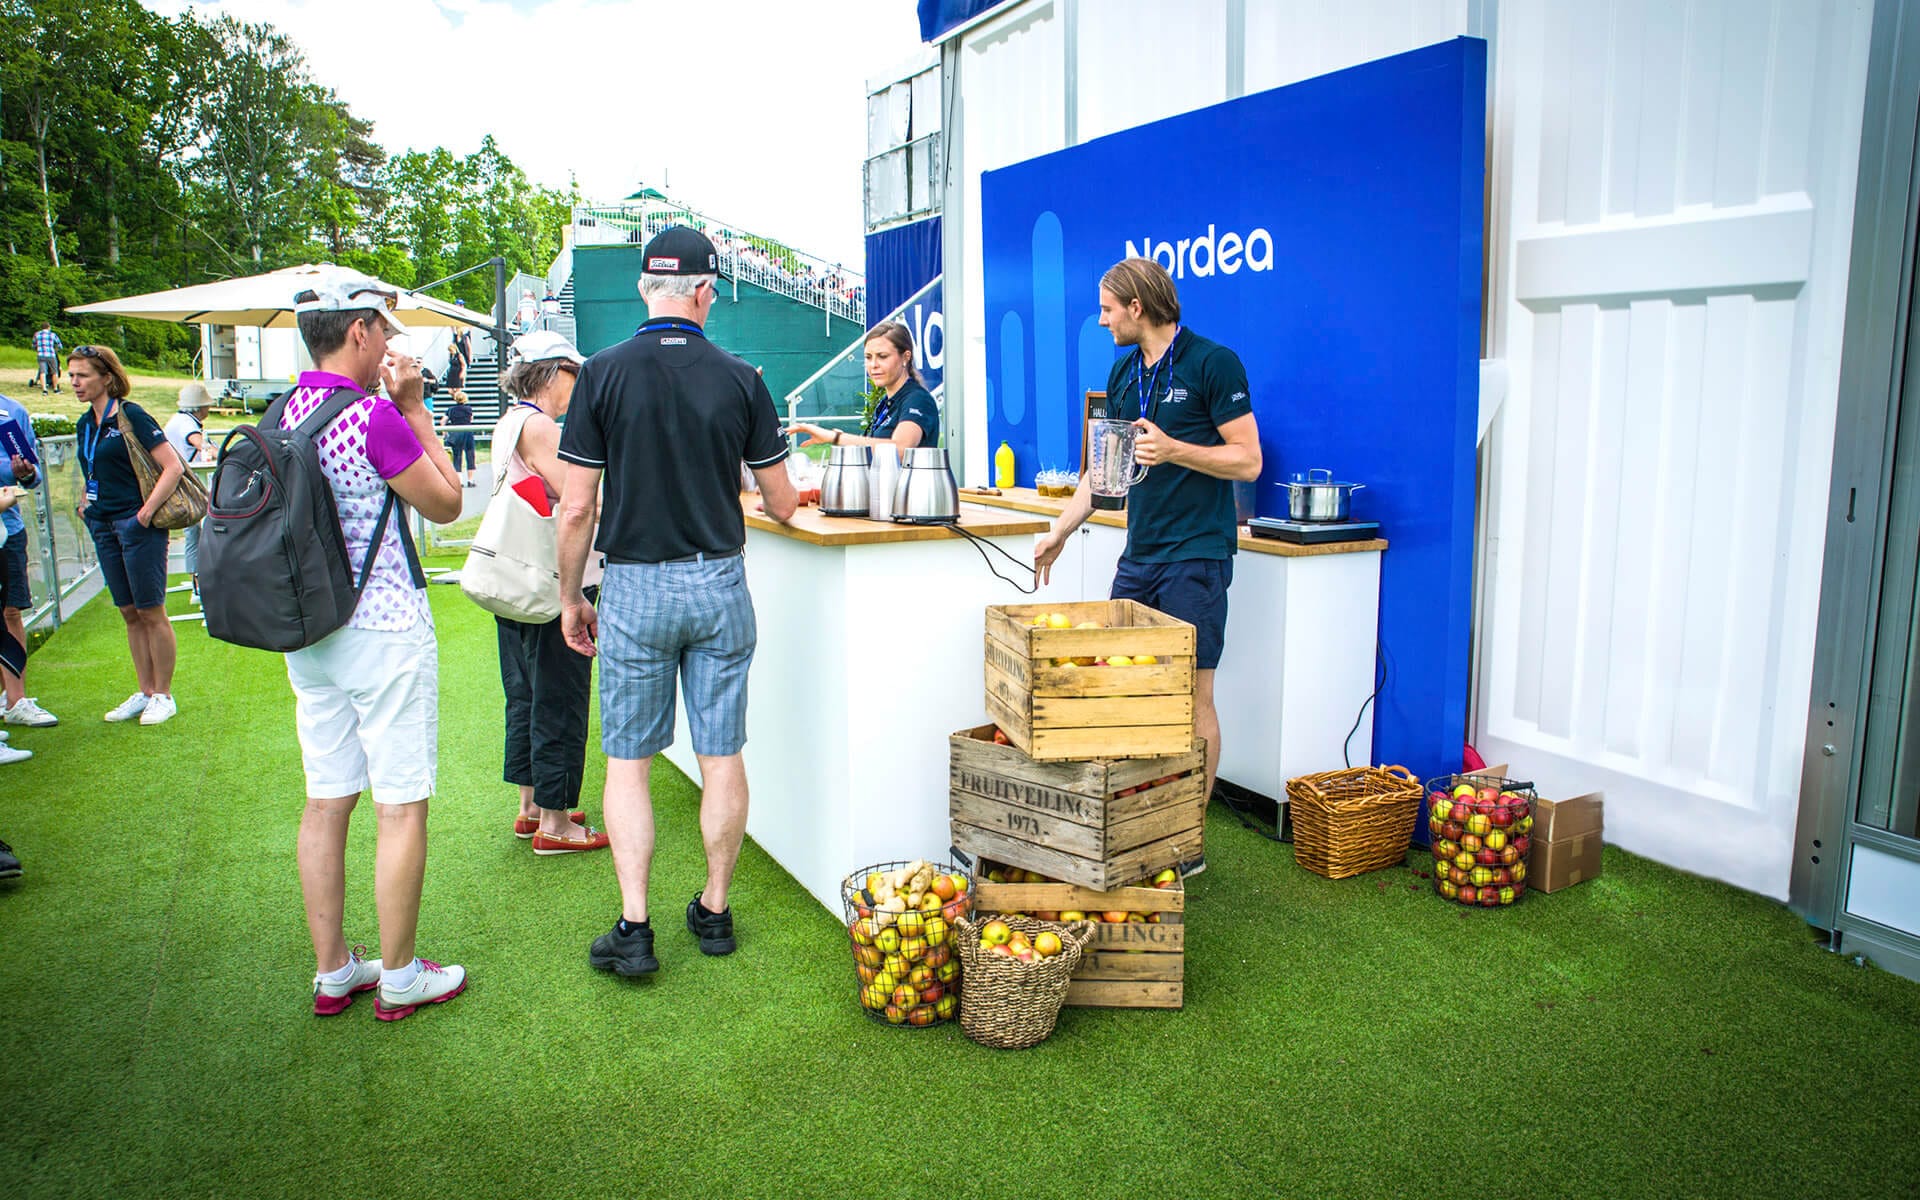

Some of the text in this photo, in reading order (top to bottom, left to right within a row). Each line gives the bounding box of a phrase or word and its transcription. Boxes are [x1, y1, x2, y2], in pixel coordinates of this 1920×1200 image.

[961, 771, 1091, 816] FRUITVEILING
[1007, 812, 1040, 836] 1973
[1091, 923, 1165, 943] ILING
